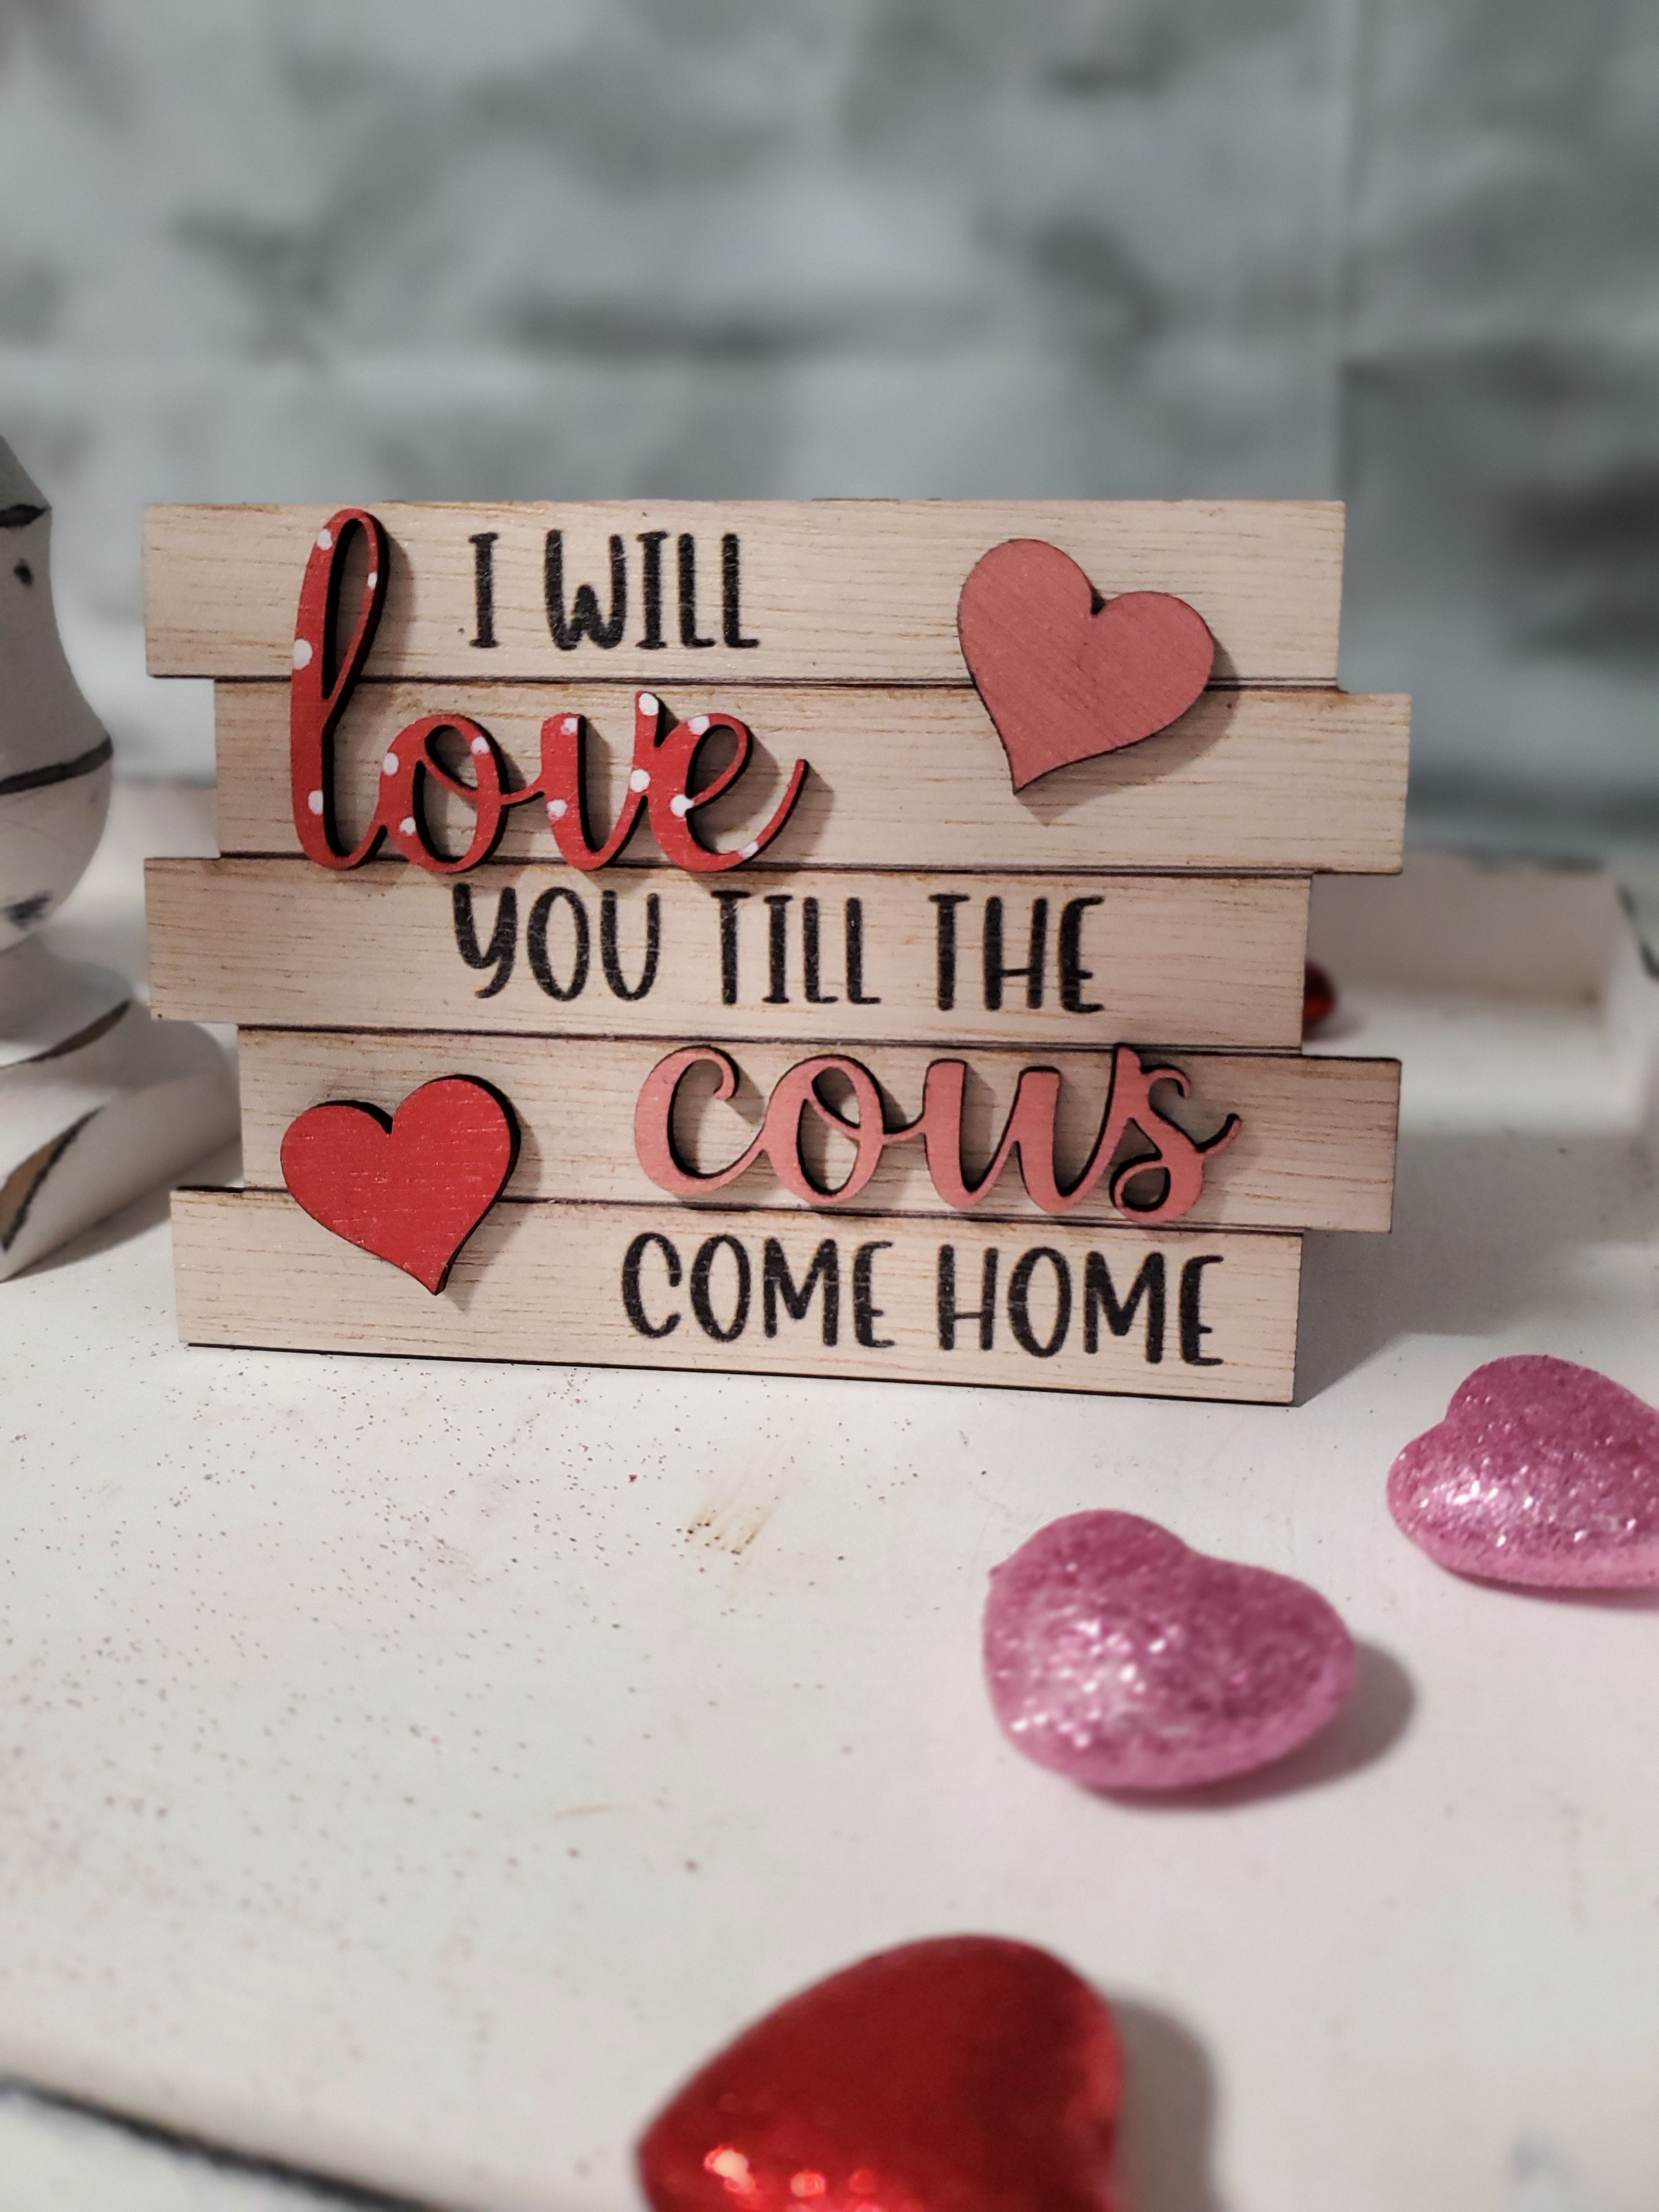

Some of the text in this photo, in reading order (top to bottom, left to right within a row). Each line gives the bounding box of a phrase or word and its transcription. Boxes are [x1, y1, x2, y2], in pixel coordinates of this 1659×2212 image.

[468, 529, 760, 651] I WILL
[289, 507, 809, 873] love
[452, 881, 1106, 1014] YOU TILL THE
[634, 1042, 1243, 1224] cows
[621, 1232, 1224, 1366] COME HOME
